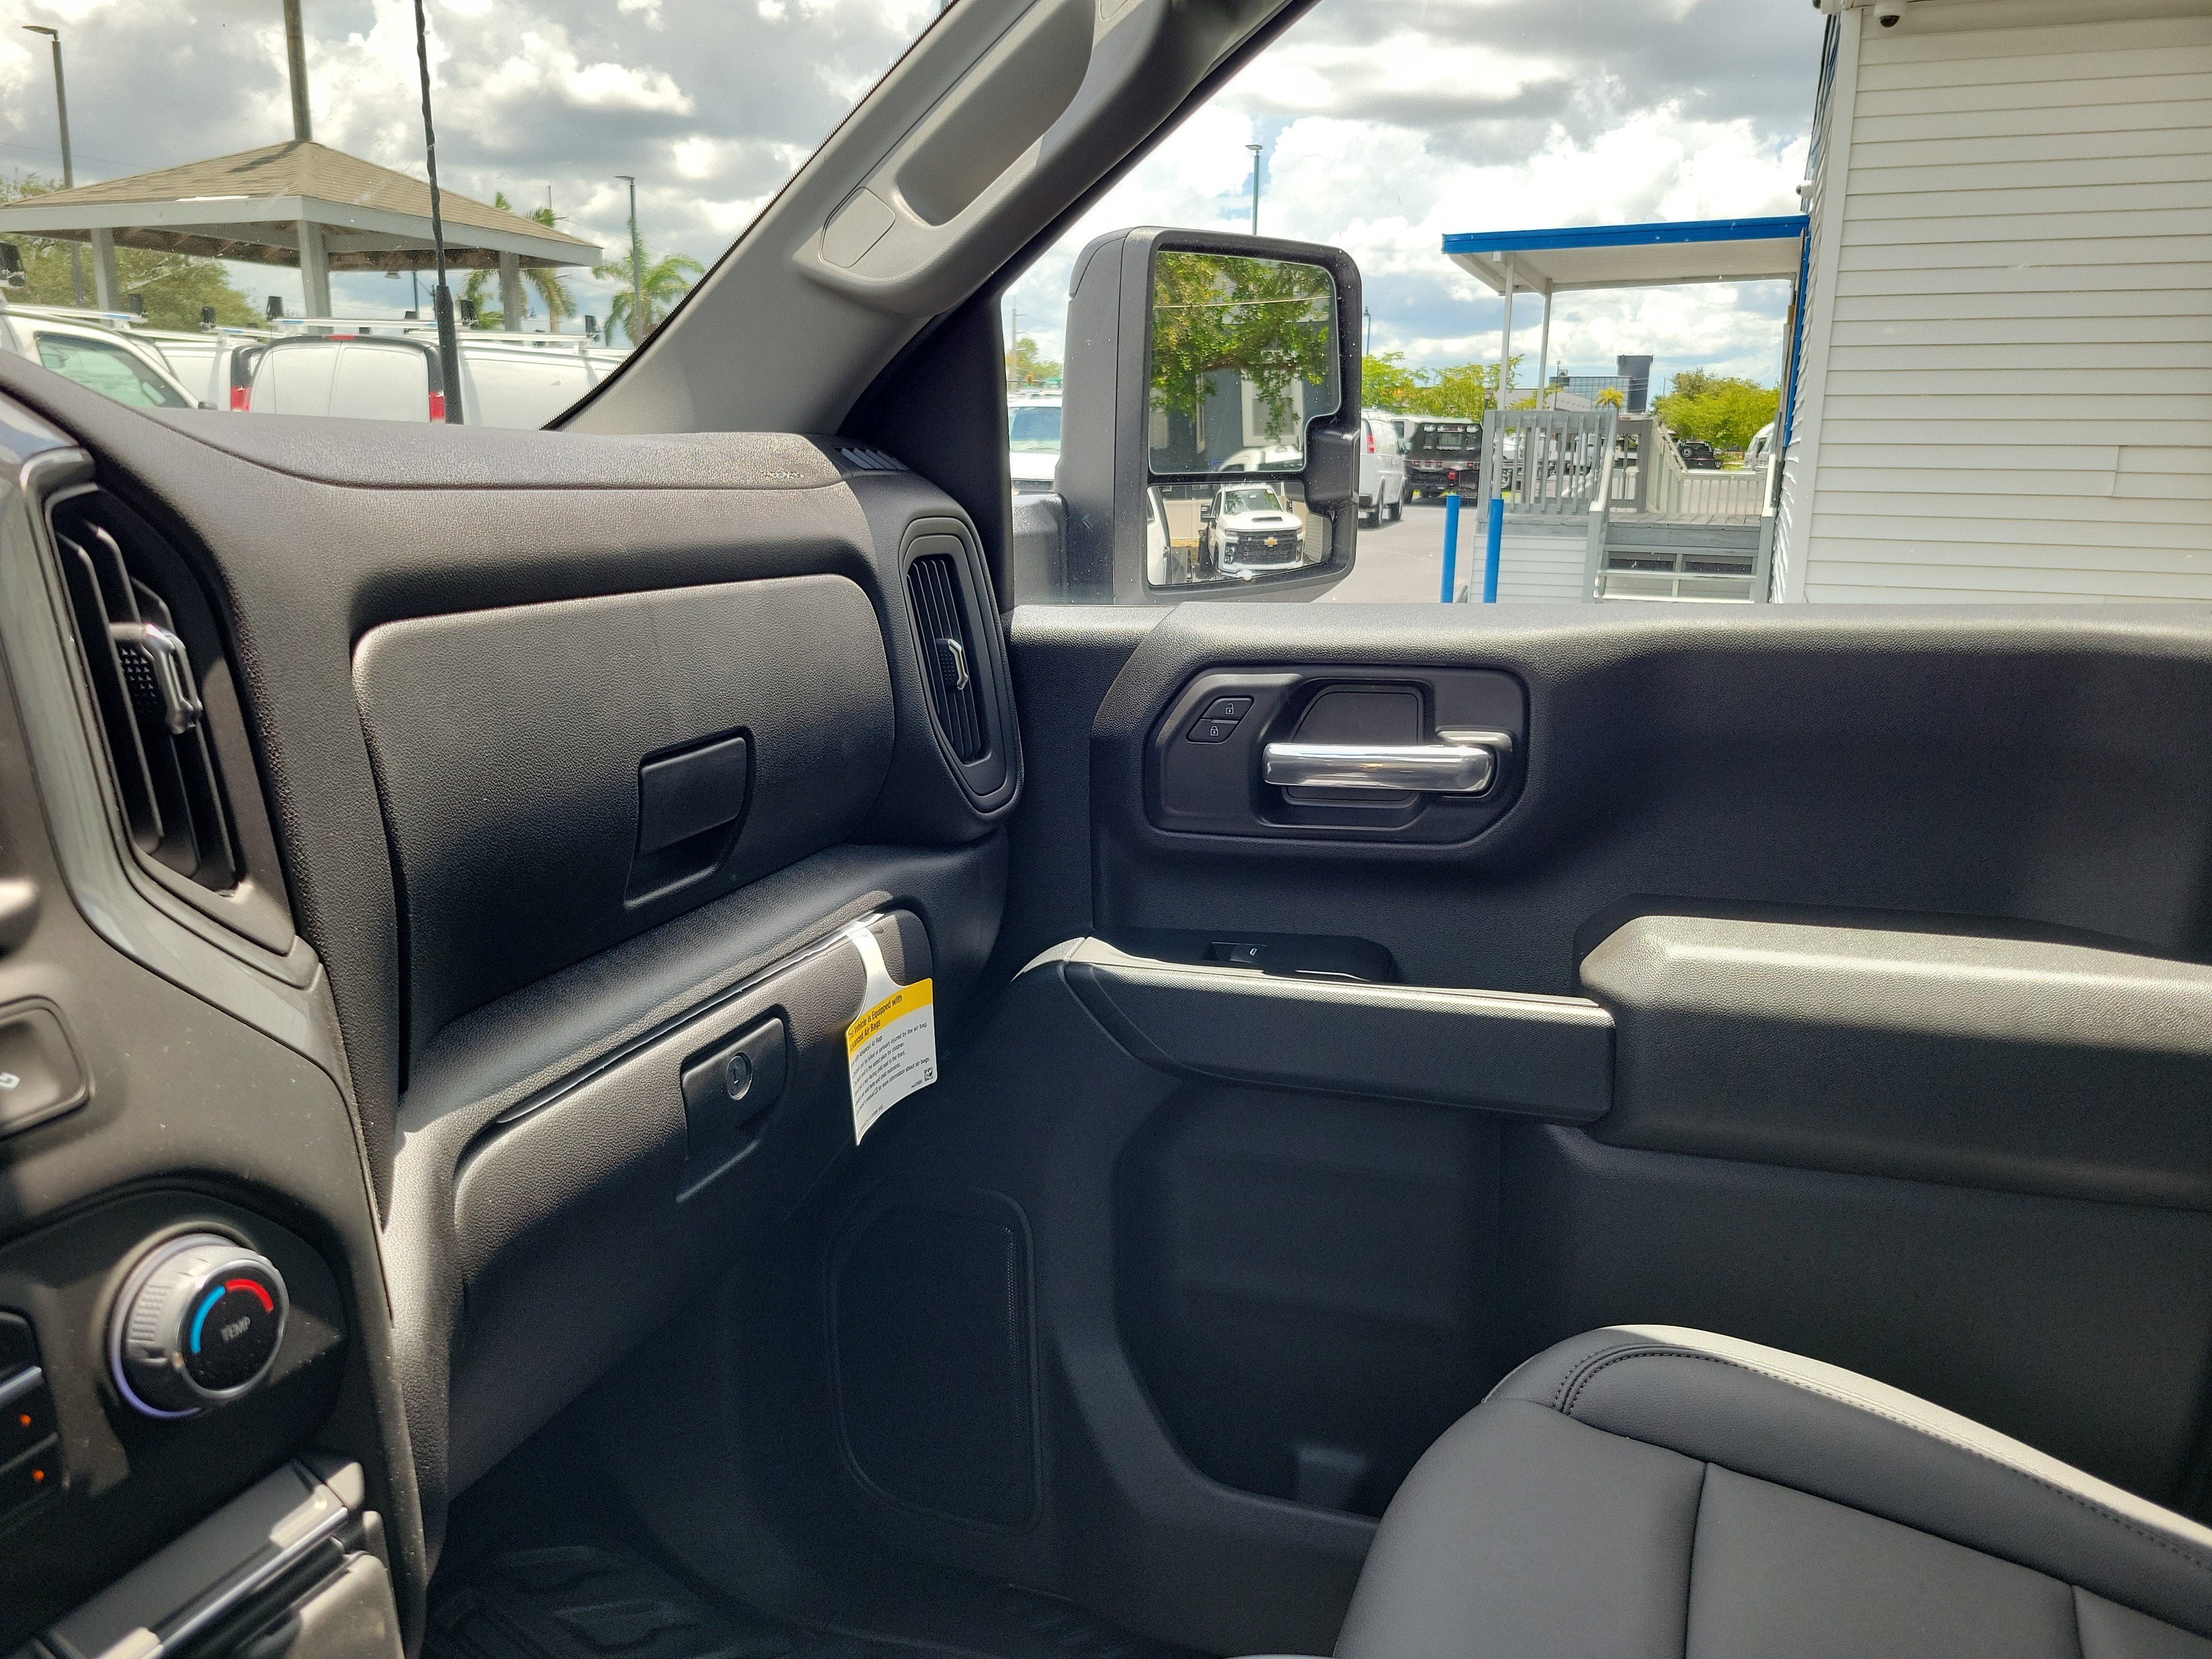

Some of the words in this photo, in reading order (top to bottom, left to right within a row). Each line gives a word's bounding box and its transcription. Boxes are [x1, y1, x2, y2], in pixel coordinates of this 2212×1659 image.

[854, 1019, 867, 1034] Vehicle
[872, 1001, 891, 1020] Equipped
[892, 994, 902, 1006] with
[871, 1020, 881, 1032] Bags
[891, 1034, 902, 1043] injured
[906, 1063, 915, 1072] about
[221, 1317, 251, 1342] TEMP
